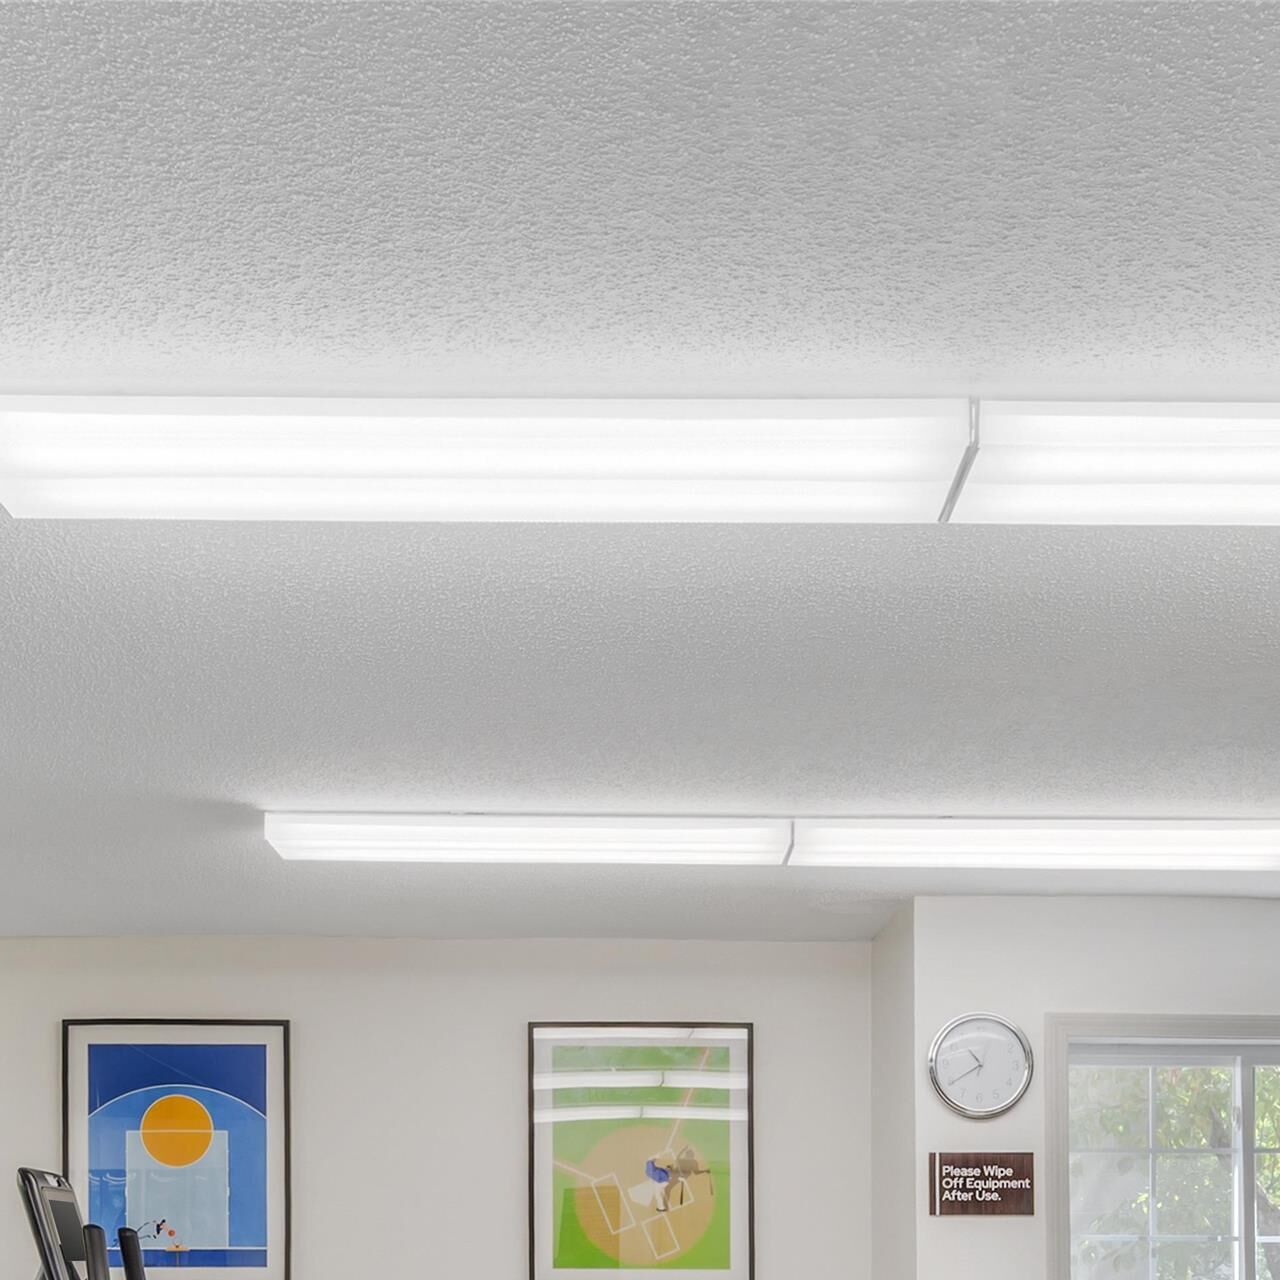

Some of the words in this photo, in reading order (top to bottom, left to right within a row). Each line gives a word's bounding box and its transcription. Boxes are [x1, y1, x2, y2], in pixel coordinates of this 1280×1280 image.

[942, 1165, 981, 1177] Please
[983, 1165, 1014, 1179] Wipe
[942, 1178, 964, 1189] Off
[966, 1178, 1031, 1191] Equipment
[942, 1190, 974, 1201] After
[975, 1190, 1002, 1201] Use.
